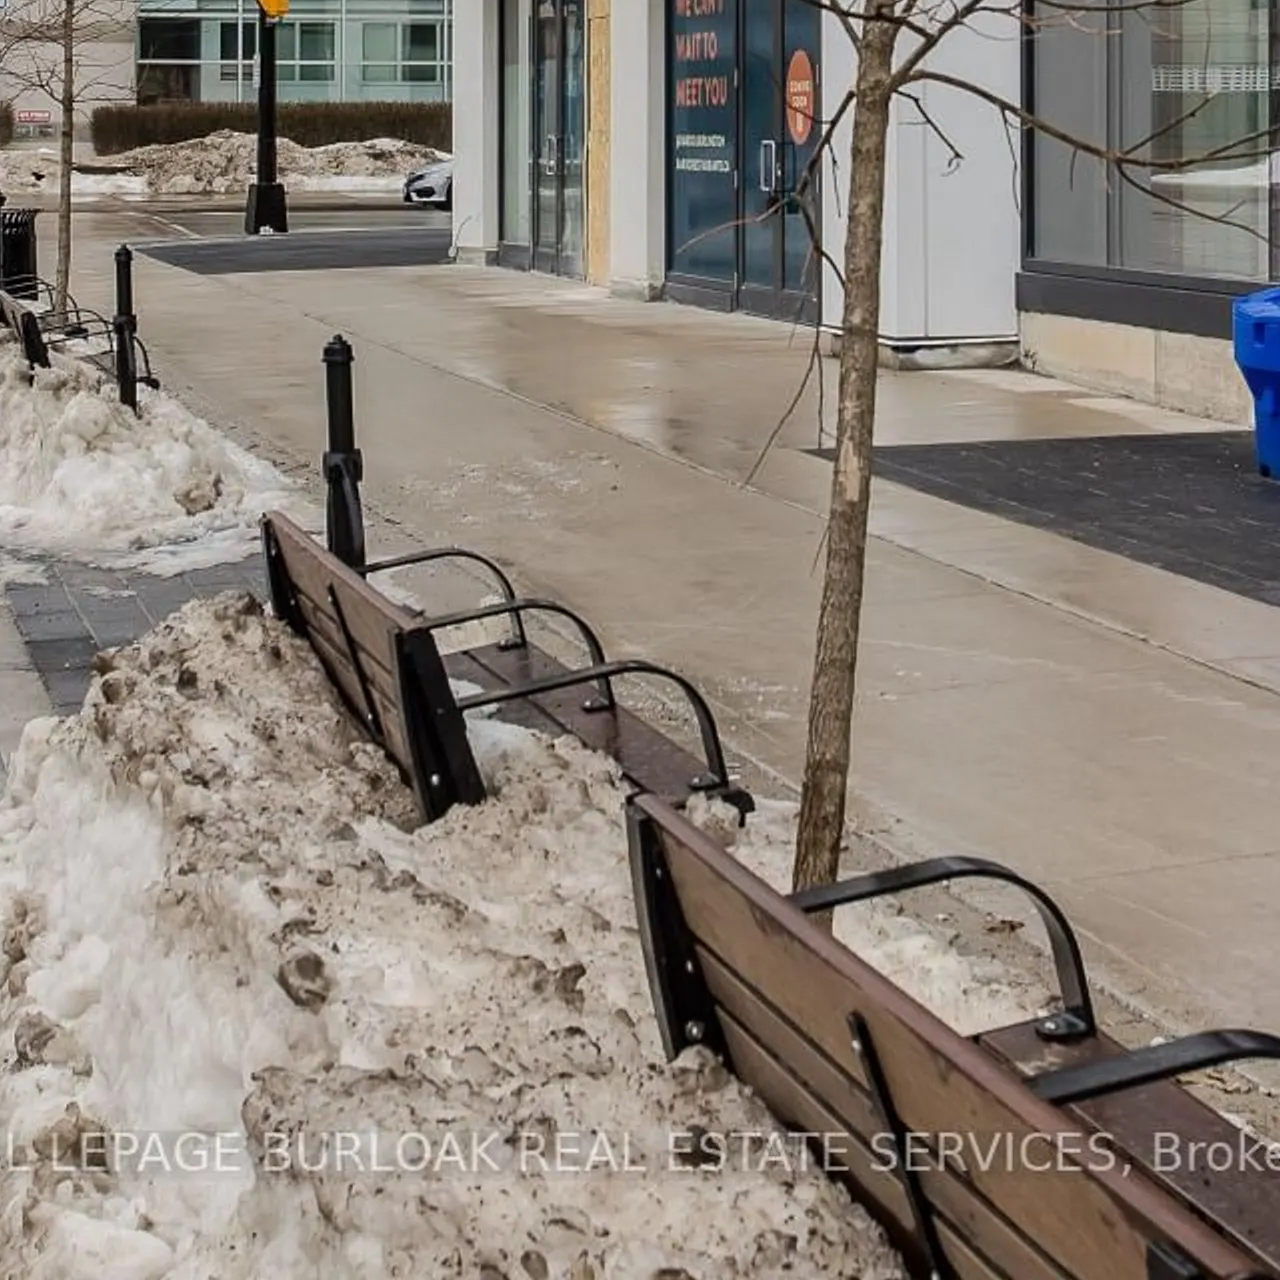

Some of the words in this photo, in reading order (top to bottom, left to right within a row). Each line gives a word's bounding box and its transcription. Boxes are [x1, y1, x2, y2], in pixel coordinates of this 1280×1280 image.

[675, 32, 701, 61] WAIT
[702, 31, 718, 60] TO
[675, 77, 703, 107] MEET
[704, 74, 728, 107] YOU
